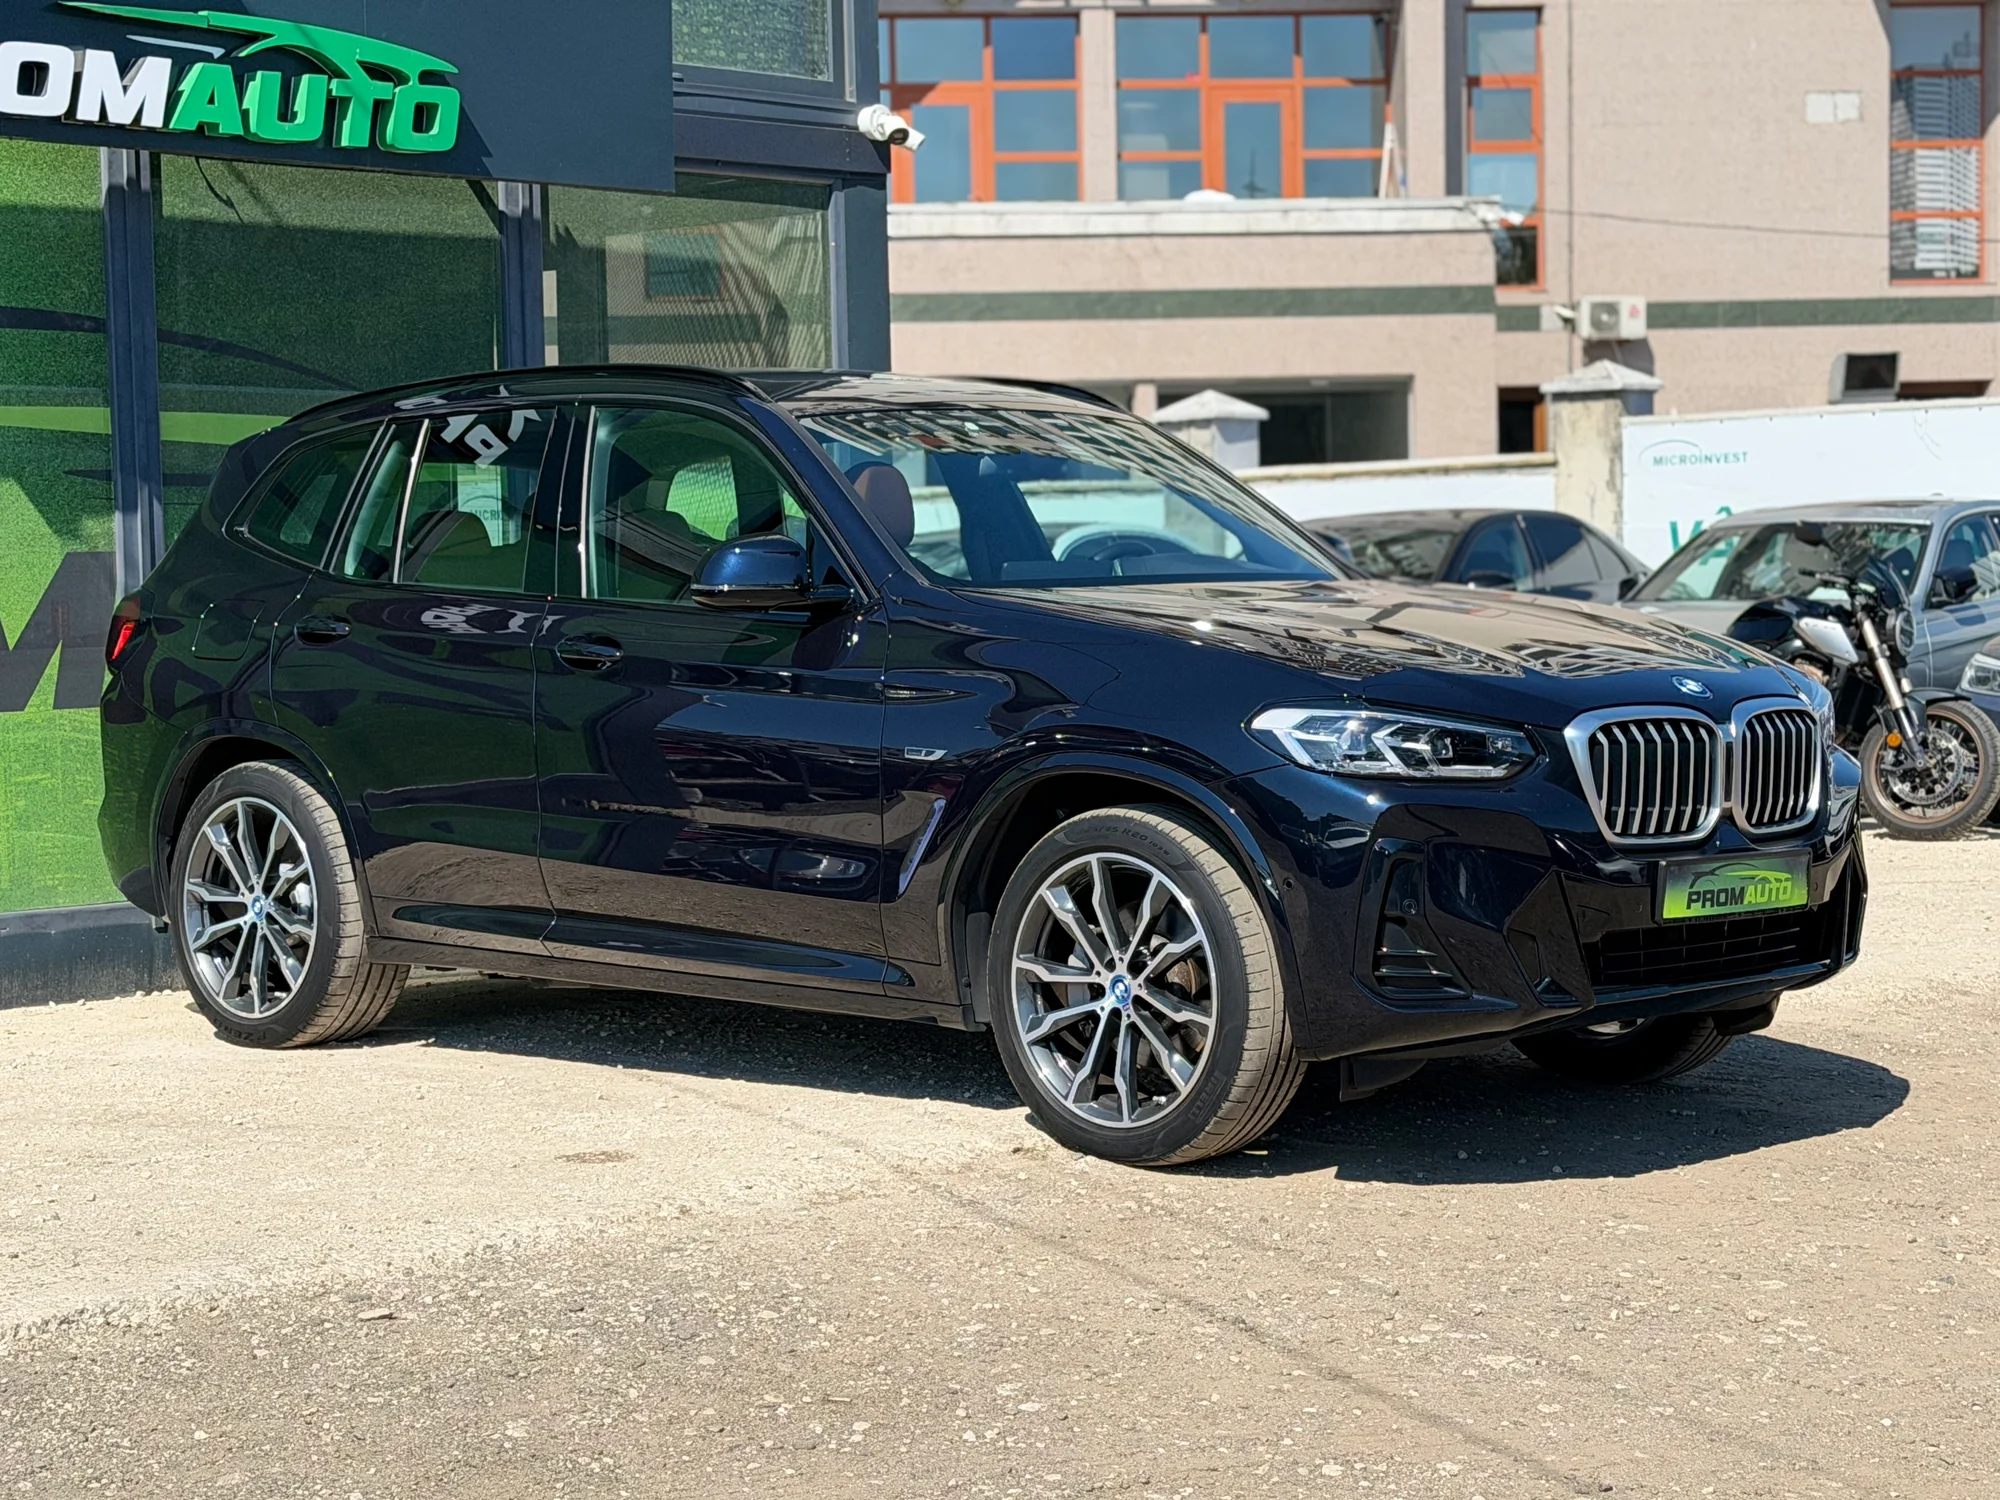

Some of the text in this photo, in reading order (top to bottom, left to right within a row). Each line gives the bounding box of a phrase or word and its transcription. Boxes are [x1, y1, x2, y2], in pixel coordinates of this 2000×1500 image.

[0, 41, 461, 153] OMAUTO
[1653, 452, 1748, 467] MICROINVEST
[1121, 827, 1149, 841] R20
[1686, 880, 1792, 910] PROMAUTO
